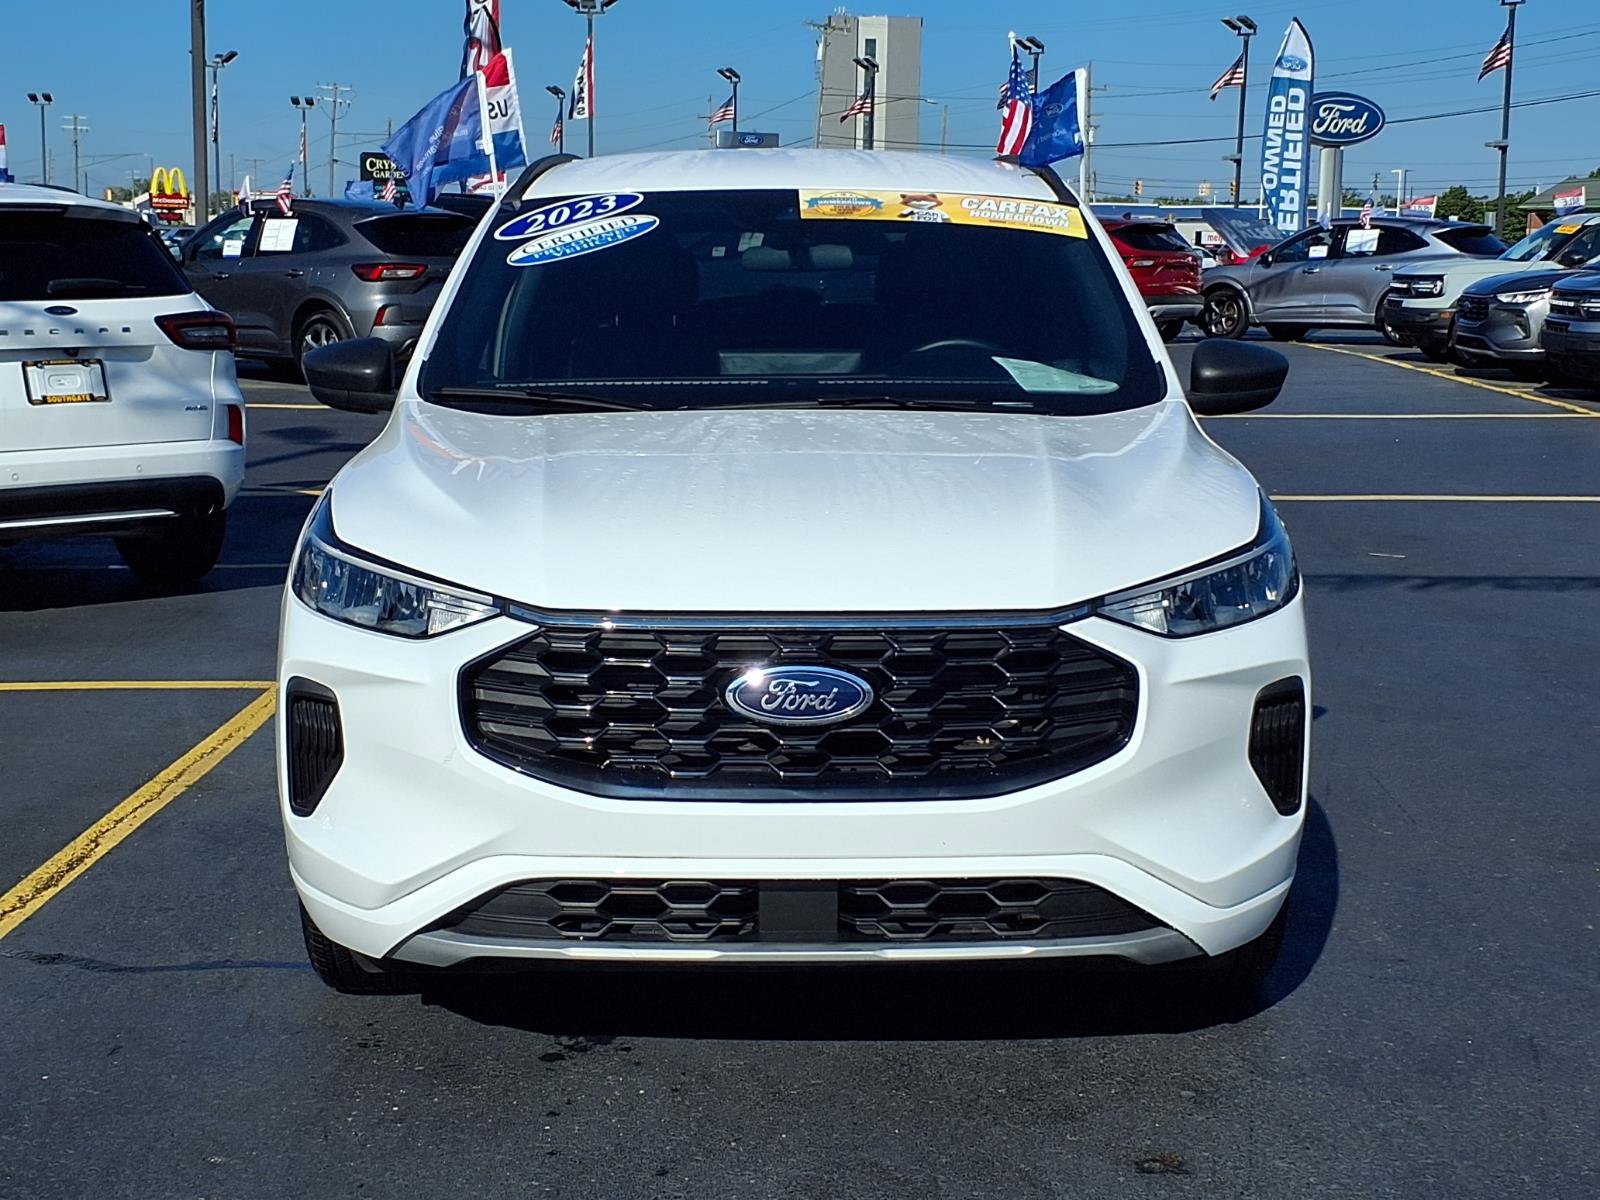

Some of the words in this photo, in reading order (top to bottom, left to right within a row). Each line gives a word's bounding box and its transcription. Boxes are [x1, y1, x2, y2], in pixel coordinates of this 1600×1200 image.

[1312, 103, 1369, 135] Ford
[744, 135, 759, 144] Ford
[524, 195, 616, 235] 2023
[961, 198, 1070, 219] CARFAX
[969, 209, 1070, 228] HOMEGROWN
[522, 216, 638, 254] CERTIFIED
[0, 326, 132, 336] ESCAPE
[46, 394, 92, 403] SOUTHGATE
[760, 678, 839, 711] Ford
